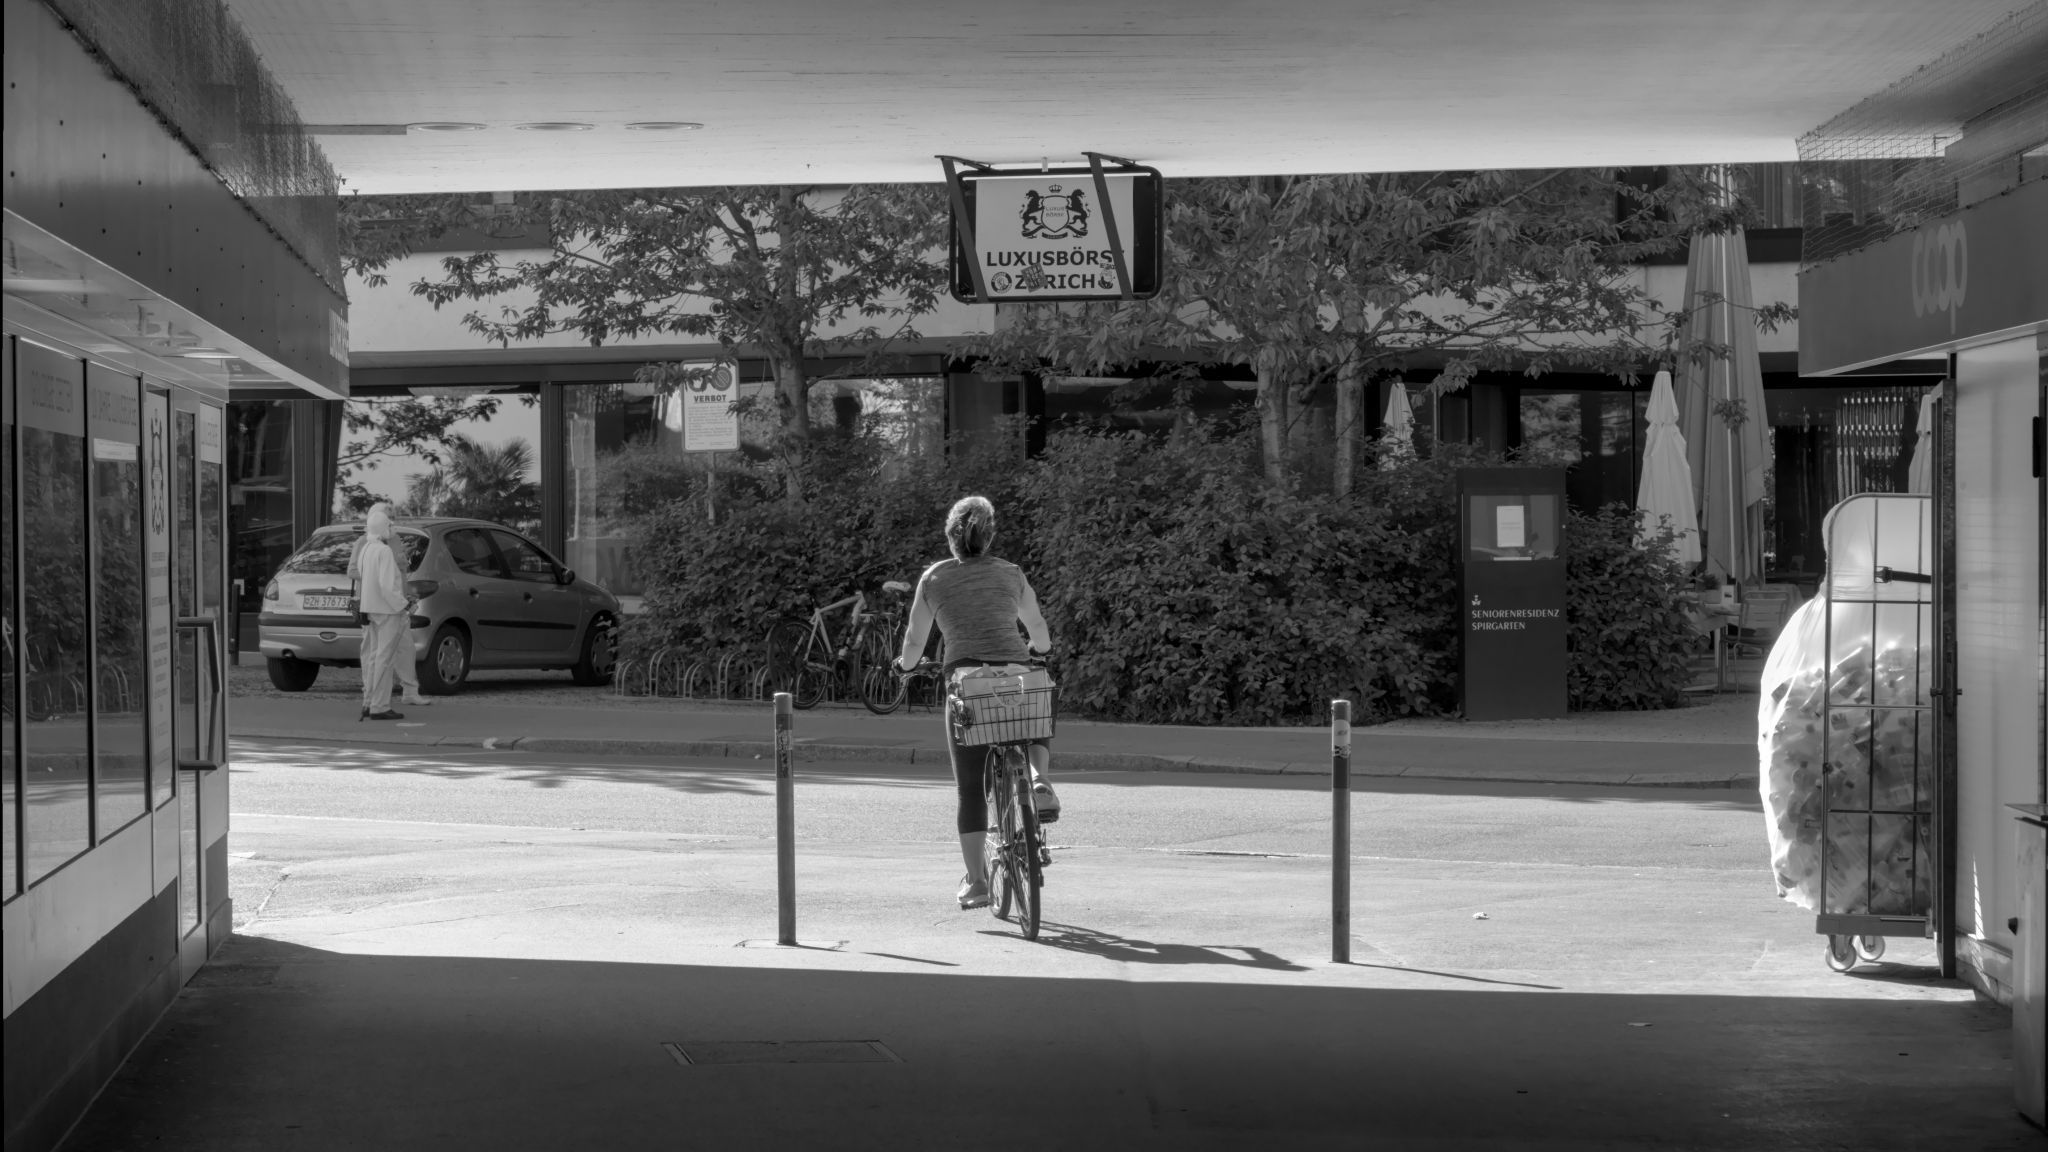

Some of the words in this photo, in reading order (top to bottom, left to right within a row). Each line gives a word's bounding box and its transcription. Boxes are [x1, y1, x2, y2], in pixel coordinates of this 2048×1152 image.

[986, 246, 1123, 266] LUXUSBÖRS
[1015, 273, 1096, 289] ZRICH
[1471, 608, 1560, 619] SENIORENRESIDENZ
[1471, 621, 1526, 631] SPIRGARTEN
